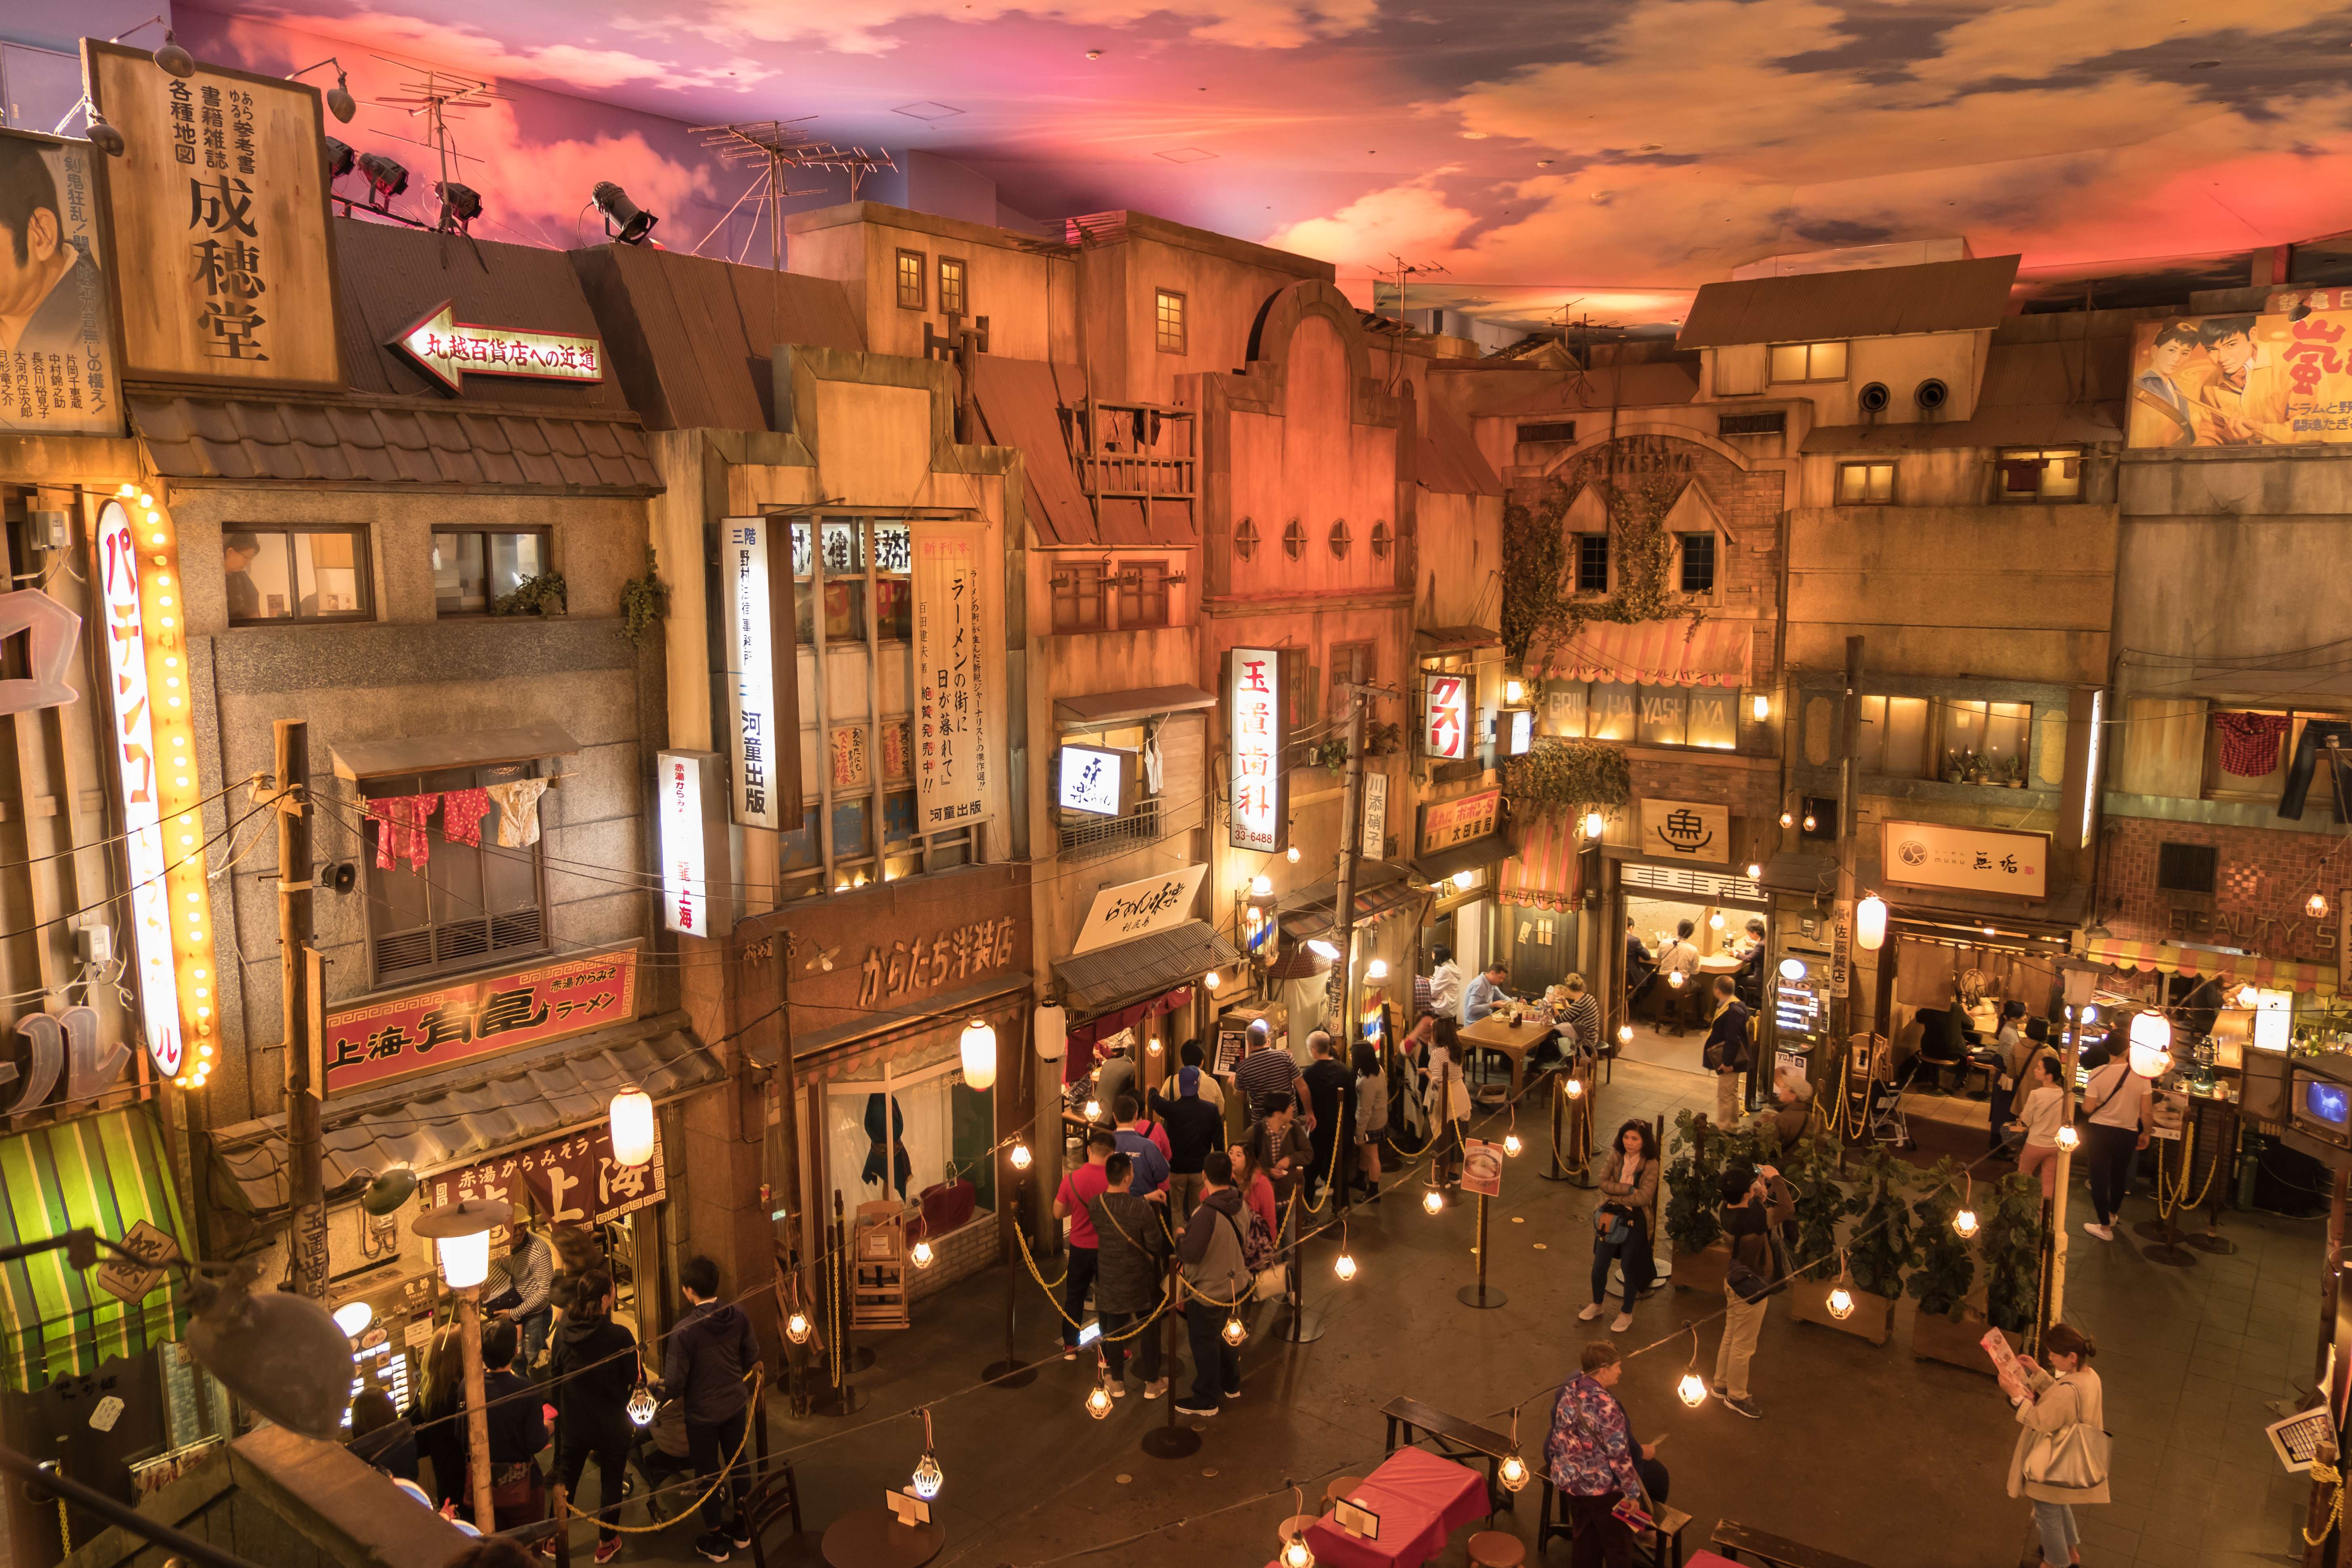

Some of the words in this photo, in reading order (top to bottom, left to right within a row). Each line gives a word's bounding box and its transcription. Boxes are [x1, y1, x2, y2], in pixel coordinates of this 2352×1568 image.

[169, 80, 196, 165] 各種地図
[201, 85, 229, 170] 書籍雑誌
[188, 175, 270, 361] 成穂堂
[49, 353, 66, 408] 中村錦之助
[424, 333, 598, 371] 丸越百貨店への近道
[2282, 319, 2352, 396] 嵐
[13, 351, 33, 418] 大河内伝次郎
[31, 352, 50, 418] 長谷川裕見子
[2293, 416, 2352, 432] 闘魂たぎ
[732, 527, 756, 545] 三階
[923, 541, 970, 555] 新刊本
[1239, 660, 1270, 819] 玉置歯科
[1431, 678, 1461, 756] クスリ
[741, 709, 766, 815] 河童出版
[930, 800, 982, 822] 河童出版
[1235, 830, 1272, 844] 33-6488
[1367, 778, 1383, 846] 川添硝子
[1973, 850, 2018, 874] 無垢
[551, 967, 617, 992] 赤湯からみそ
[858, 915, 1016, 1007] からたち洋装店
[1832, 924, 1848, 983] 佐藤質店
[556, 993, 616, 1019] ラーメン
[1778, 1053, 1794, 1064] YUJI
[458, 1136, 609, 1188] 赤湯からみそラー
